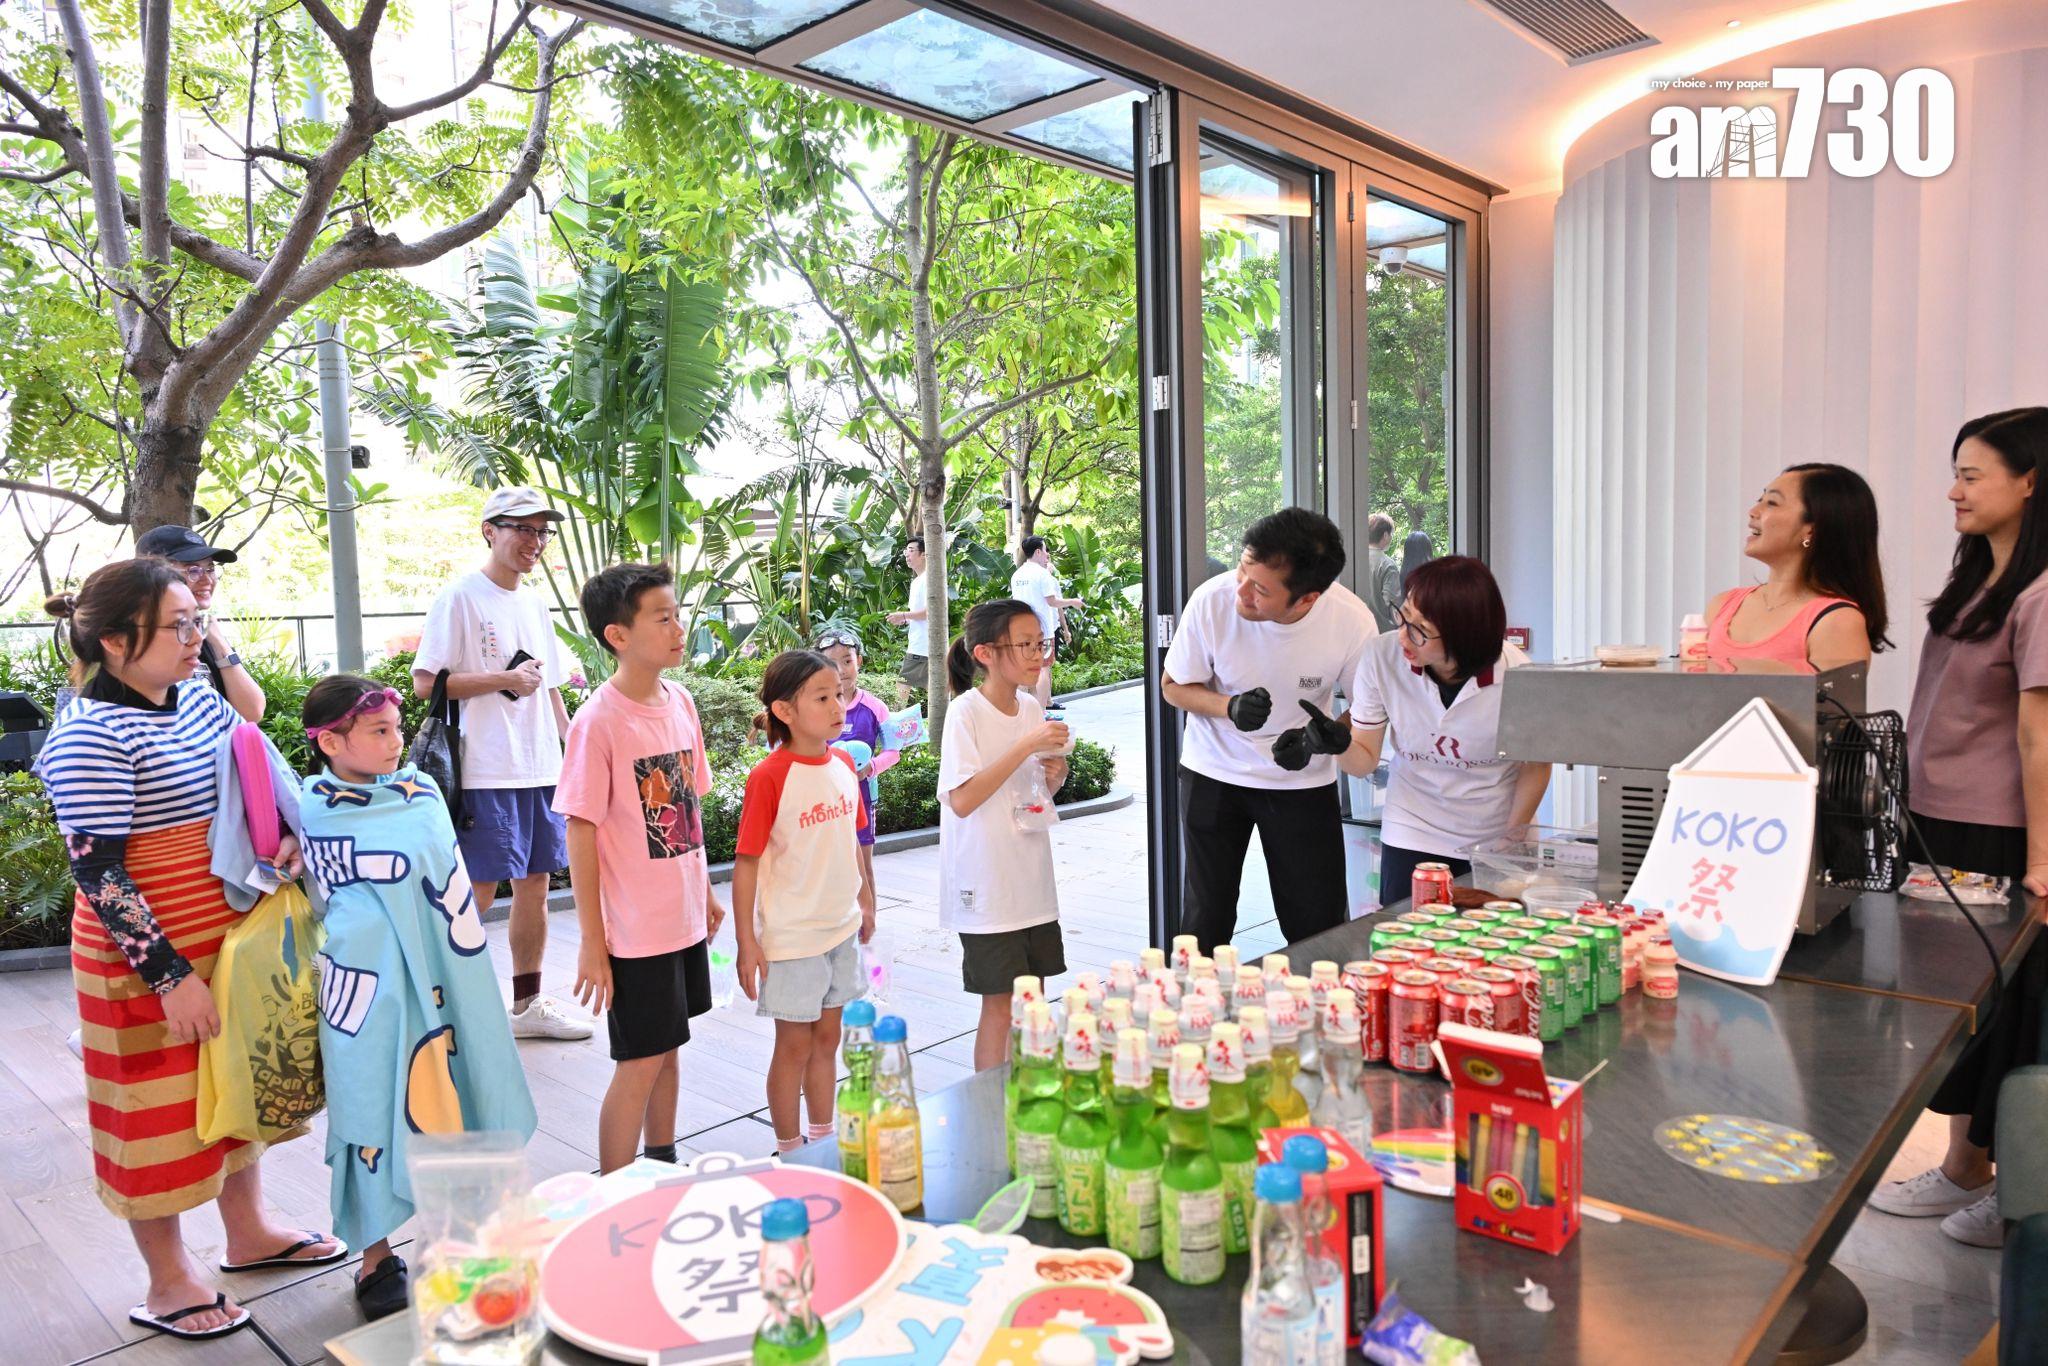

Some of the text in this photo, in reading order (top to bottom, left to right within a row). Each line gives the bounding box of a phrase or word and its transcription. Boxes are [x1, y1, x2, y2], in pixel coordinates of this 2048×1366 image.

[1671, 806, 1788, 855] KOKO
[1678, 857, 1738, 923] 祭
[1494, 1186, 1514, 1201] 48
